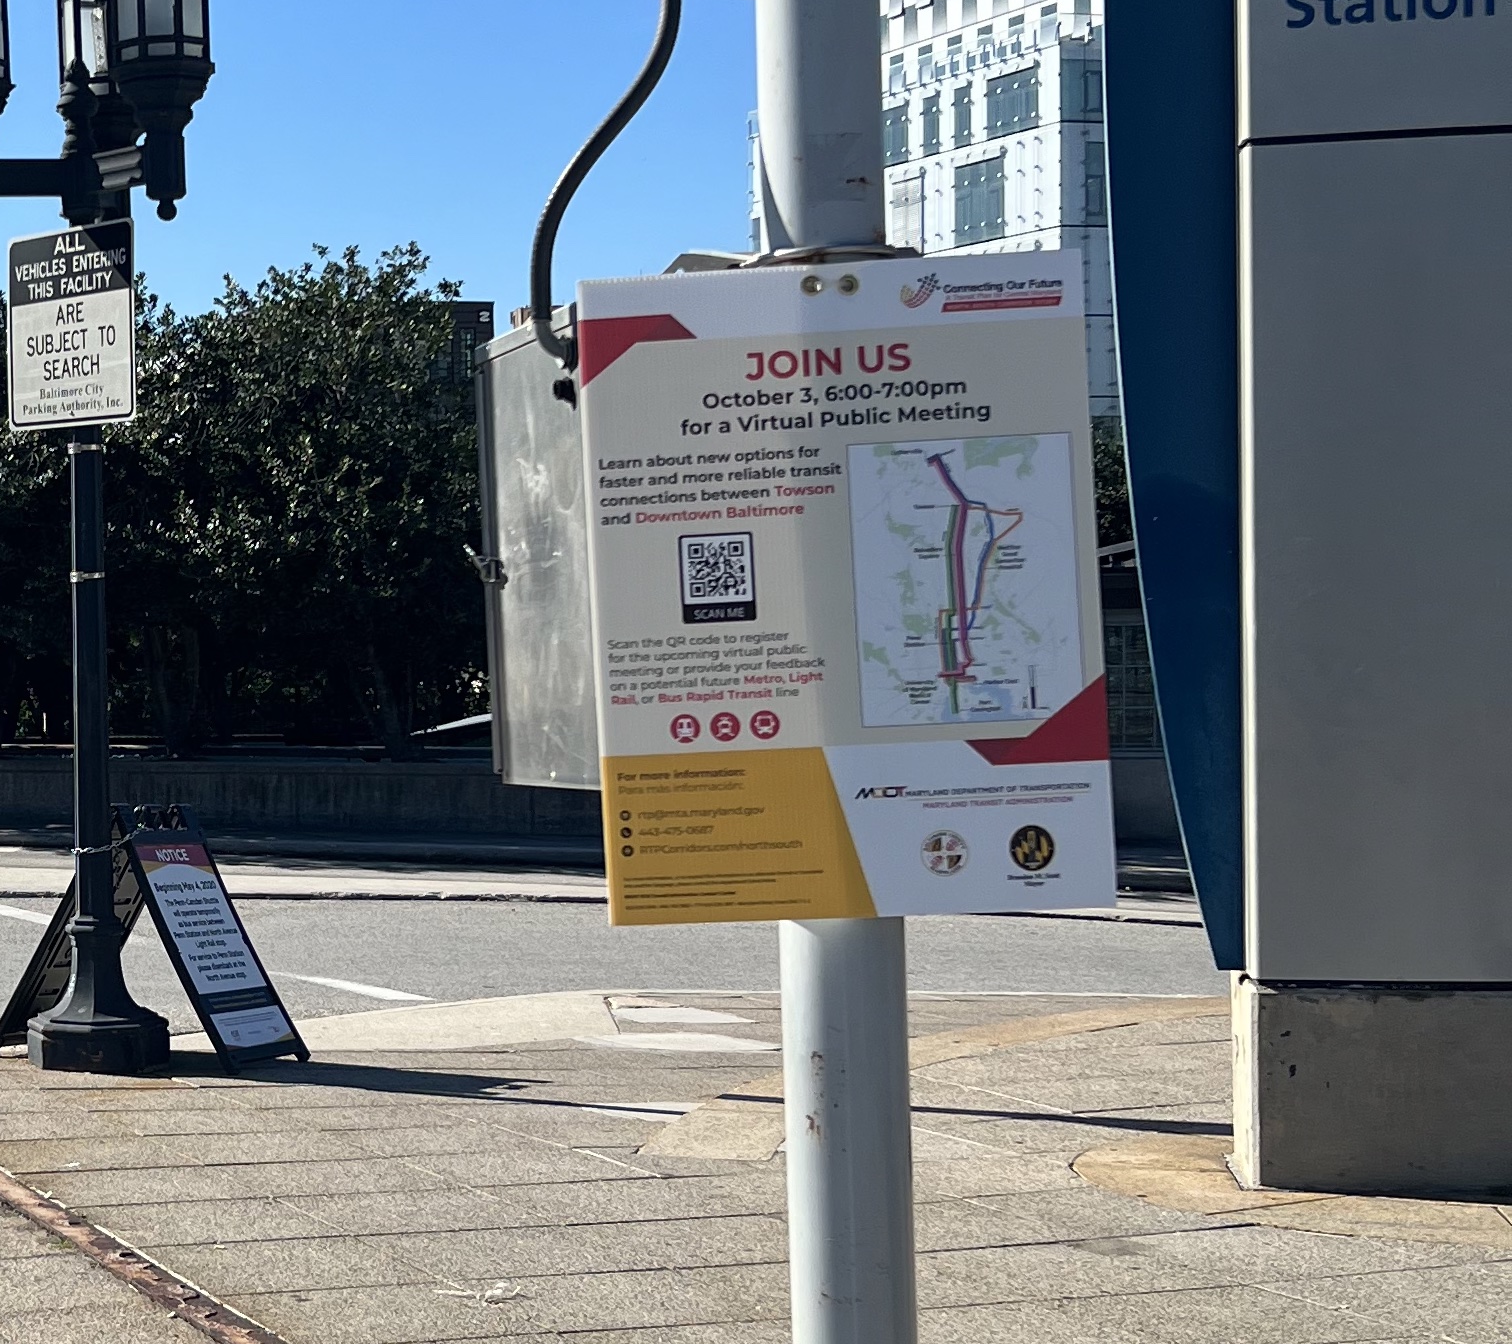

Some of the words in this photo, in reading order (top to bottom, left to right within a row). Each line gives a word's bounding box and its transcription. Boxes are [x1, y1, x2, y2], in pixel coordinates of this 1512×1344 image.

[53, 233, 86, 256] ALL
[14, 257, 67, 283] VEHICLES
[72, 247, 127, 273] ENTERING
[27, 280, 54, 301] THIS
[60, 270, 113, 296] FACILITY
[942, 281, 1004, 295] Connecting
[1006, 280, 1026, 290] Our
[1028, 278, 1063, 289] Future
[55, 301, 85, 327] ARE
[26, 328, 88, 358] SUBJECT
[97, 324, 116, 348] TO
[43, 353, 101, 382] SEARCH
[745, 347, 843, 382] JOIN
[856, 342, 912, 375] US
[39, 384, 83, 401] Baltimore
[85, 383, 105, 398] City
[702, 389, 795, 409] October
[799, 387, 819, 406] 3,
[824, 379, 968, 402] 6:00-7:00pm
[22, 401, 58, 416] Parking
[106, 396, 124, 409] Inc.
[680, 418, 710, 437] for
[718, 421, 731, 435] a
[737, 411, 814, 433] Virtual
[819, 406, 892, 428] Public
[897, 402, 992, 423] Meeting
[598, 457, 643, 471] Learn
[645, 453, 693, 469] about
[696, 452, 731, 465] new
[734, 447, 795, 464] options
[797, 445, 820, 459] for
[598, 475, 644, 490] faster
[647, 472, 678, 487] and
[682, 470, 724, 484] more
[727, 467, 787, 482] reliable
[790, 463, 842, 478] transit
[600, 491, 697, 508] connections
[700, 486, 771, 503] between
[774, 483, 836, 497] Towson
[601, 512, 631, 526] and
[635, 507, 722, 524] Downtown
[726, 502, 805, 520] Baltimore
[693, 609, 726, 621] SCAN
[726, 607, 745, 618] ME
[607, 639, 639, 650] Scan
[641, 637, 663, 648] the
[665, 635, 687, 648] QR
[689, 634, 721, 646] code
[723, 634, 737, 645] to
[739, 631, 790, 645] register
[608, 653, 626, 664] for
[629, 651, 650, 663] the
[653, 649, 720, 664] upcoming
[722, 646, 764, 658] virtual
[766, 643, 808, 658] public
[609, 665, 663, 679] meeting
[666, 666, 680, 675] or
[683, 662, 732, 676] provide
[734, 661, 763, 673] your
[766, 657, 826, 670] feedback
[609, 682, 628, 692] on
[640, 676, 698, 692] potential
[700, 676, 741, 688] future
[743, 674, 786, 686] Metro,
[788, 671, 824, 685] Light
[641, 695, 655, 705] or
[658, 692, 683, 704] Bus
[686, 689, 725, 704] Rapid
[727, 687, 773, 701] Transit
[775, 686, 800, 698] line
[154, 848, 190, 862] NOTICE
